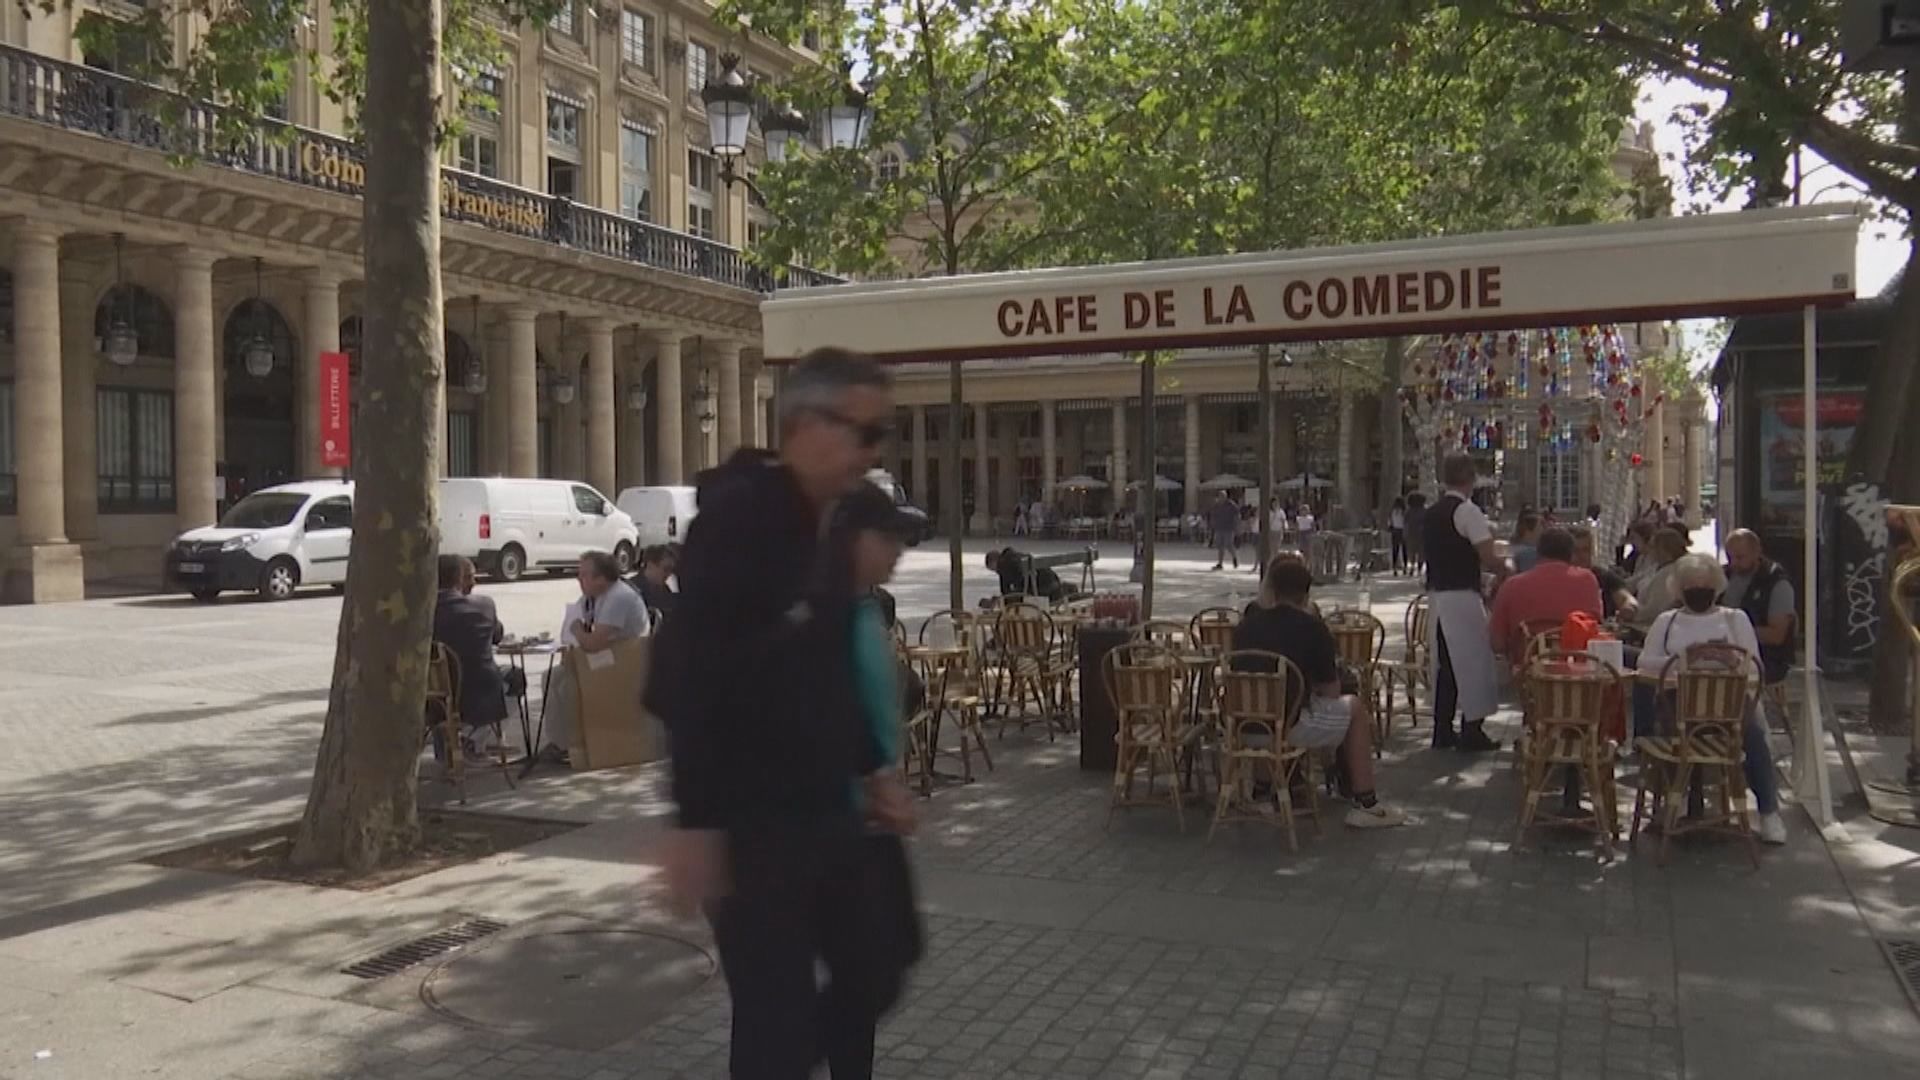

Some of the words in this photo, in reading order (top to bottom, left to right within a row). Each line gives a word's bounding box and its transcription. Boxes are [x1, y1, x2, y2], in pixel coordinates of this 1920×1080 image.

[997, 294, 1098, 337] CAFE
[1123, 289, 1176, 330] DE
[1203, 284, 1256, 326] LA
[1282, 265, 1501, 322] COMEDIE
